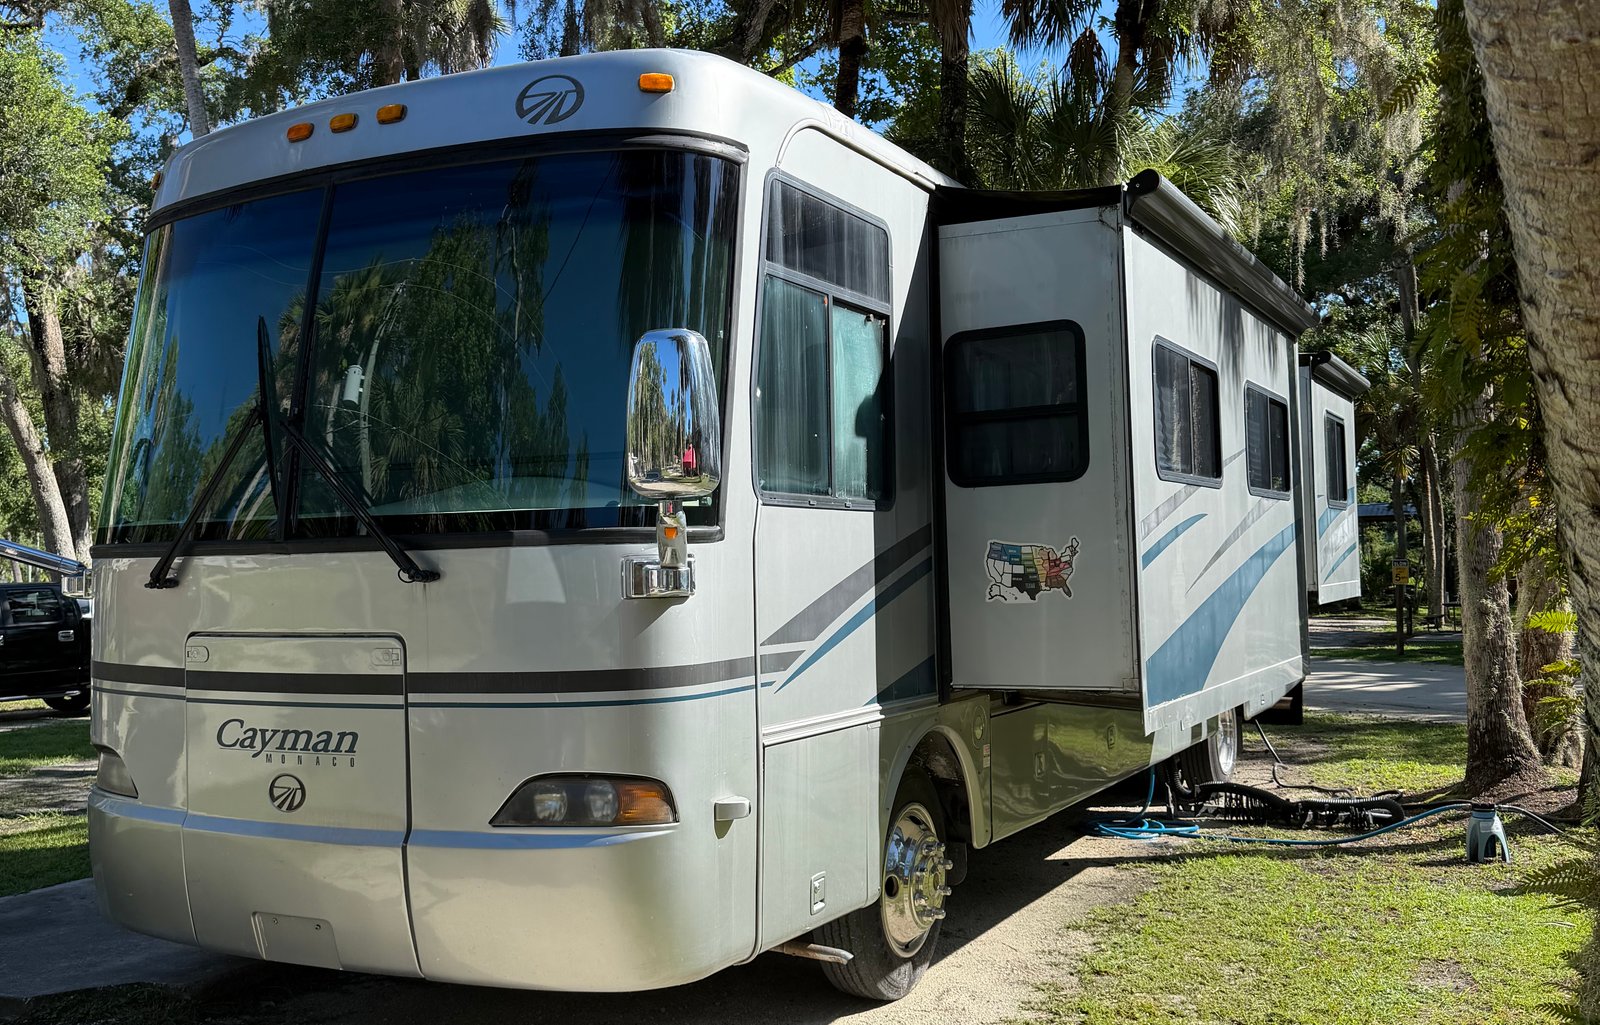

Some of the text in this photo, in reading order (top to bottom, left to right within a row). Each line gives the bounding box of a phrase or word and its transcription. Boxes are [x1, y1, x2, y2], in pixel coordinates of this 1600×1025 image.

[1395, 573, 1401, 582] 5
[216, 718, 359, 758] Cayman
[265, 753, 355, 768] MONACO
